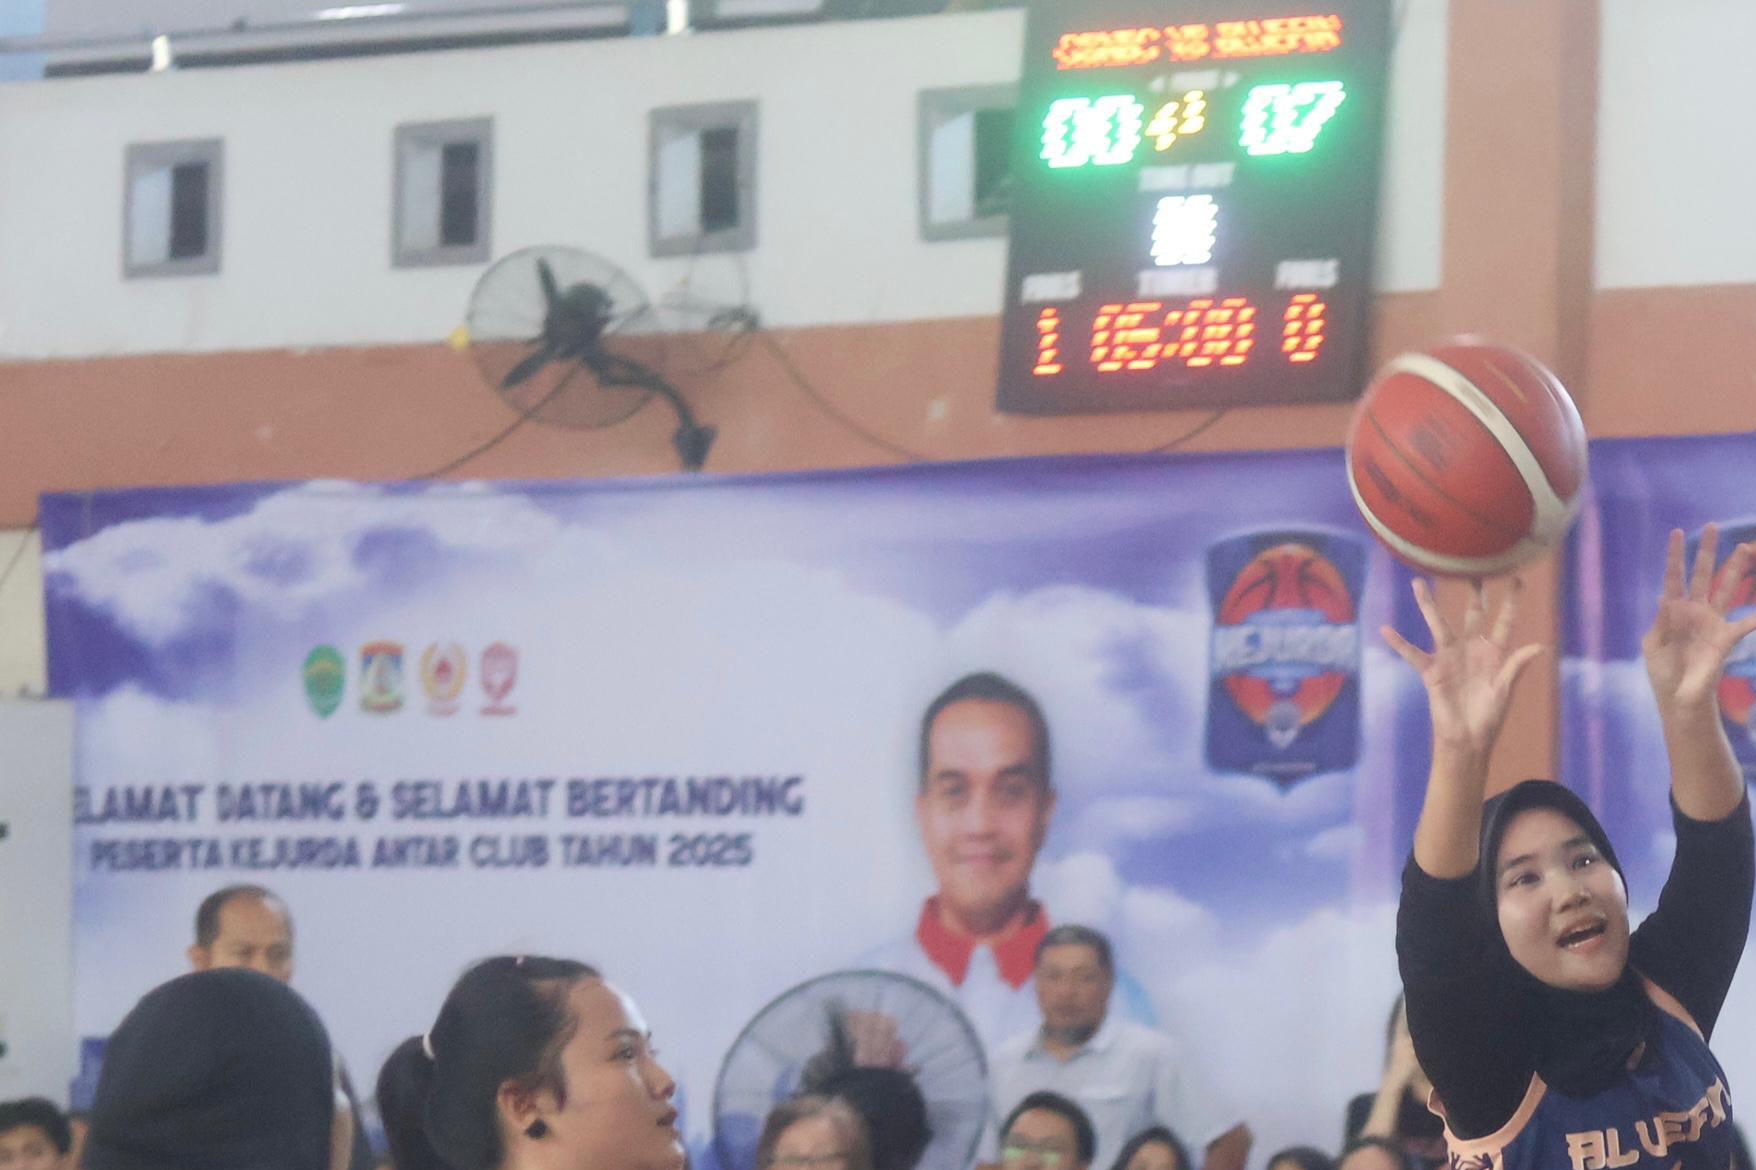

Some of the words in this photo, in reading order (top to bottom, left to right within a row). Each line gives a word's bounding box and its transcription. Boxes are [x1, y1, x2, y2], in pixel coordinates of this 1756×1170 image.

[1040, 95, 1144, 169] 00
[1239, 80, 1347, 156] 07
[1032, 306, 1063, 375] 1
[1280, 292, 1327, 363] 0
[215, 782, 345, 821] DATANG
[390, 780, 554, 819] SELAMAT
[564, 776, 803, 818] BERTANDING
[90, 837, 225, 871] PESERTA
[370, 834, 460, 868] ANTAR
[469, 834, 549, 868] CLUB
[557, 833, 658, 867] TAHUN
[665, 831, 754, 867] 2025
